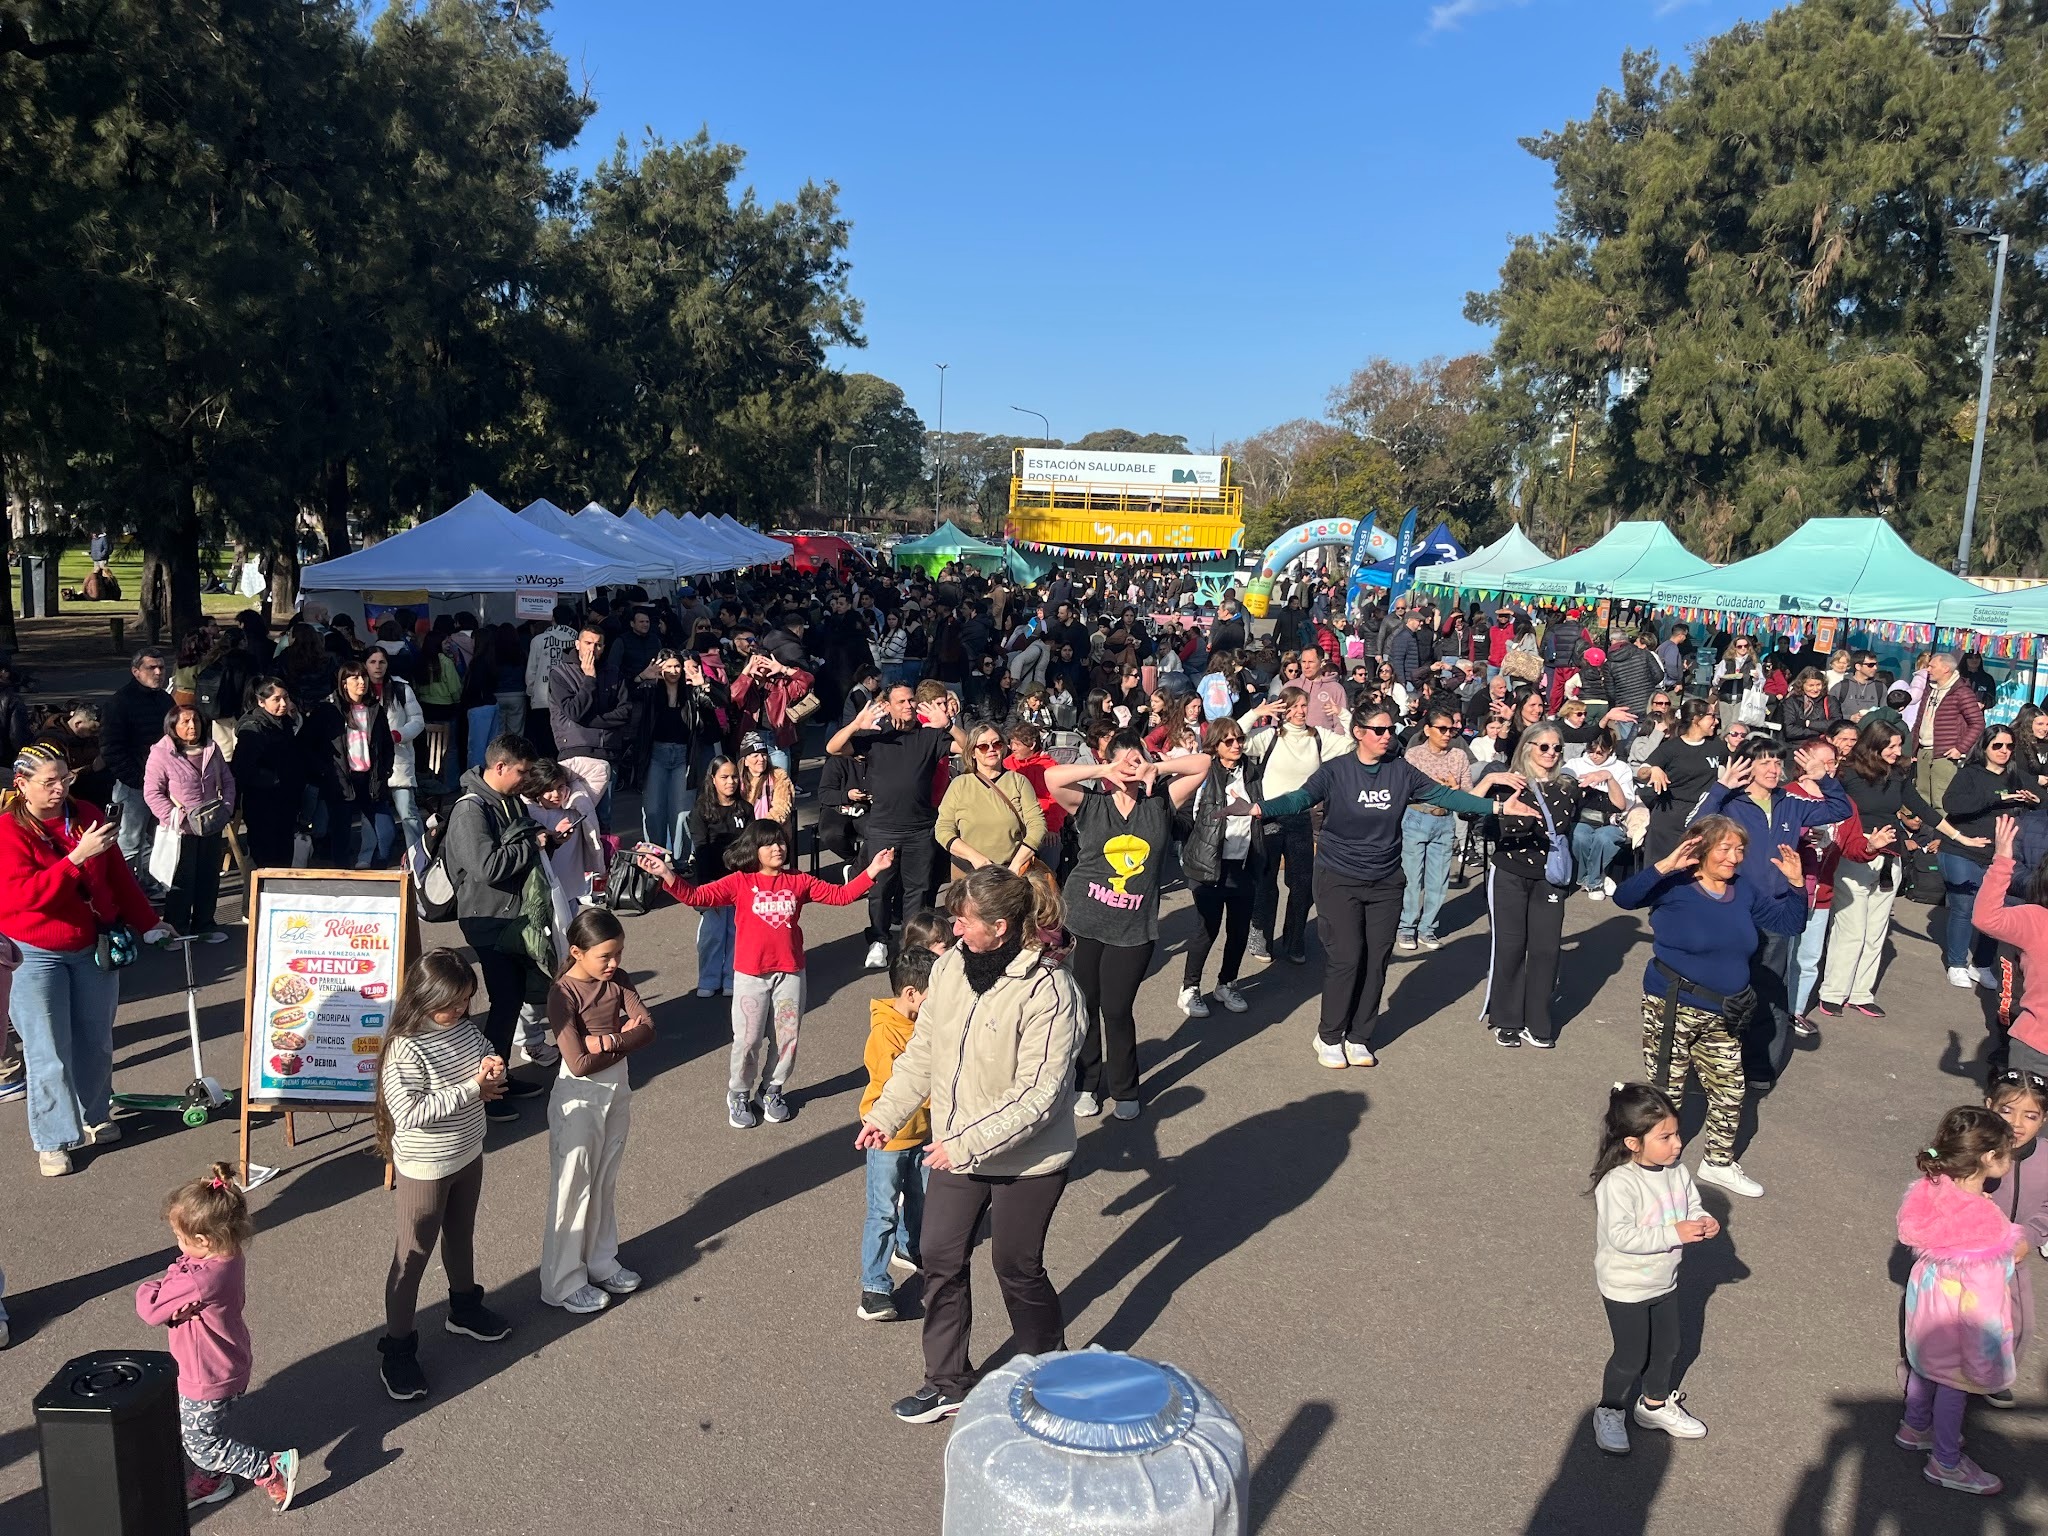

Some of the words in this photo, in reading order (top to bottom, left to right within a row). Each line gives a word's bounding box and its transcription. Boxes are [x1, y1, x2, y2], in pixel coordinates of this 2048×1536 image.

[1028, 460, 1086, 470] ESTACIÓN
[1088, 462, 1156, 473] SALUDABLE
[1172, 469, 1198, 484] BA
[1354, 530, 1368, 562] ROSSI
[1400, 530, 1410, 564] ROSSI
[524, 574, 564, 588] Waggs
[1658, 590, 1702, 604] Bienestar
[1716, 594, 1765, 609] Ciudadano
[1974, 608, 2009, 616] Estaciones
[1972, 615, 2008, 623] Saludables
[1358, 790, 1391, 802] ARG
[1088, 882, 1144, 910] TWEETY
[324, 919, 380, 938] Roques
[350, 938, 389, 950] GRILL
[308, 957, 359, 973] MENÚ
[319, 976, 346, 984] PARRILLA
[318, 982, 356, 992] VENEZOLANA
[364, 986, 384, 994] 12.000
[317, 1013, 350, 1022] CHORIPAN
[316, 1036, 345, 1045] PINCHOS
[314, 1058, 337, 1067] BEBIDA
[983, 1116, 1021, 1140] COOK
